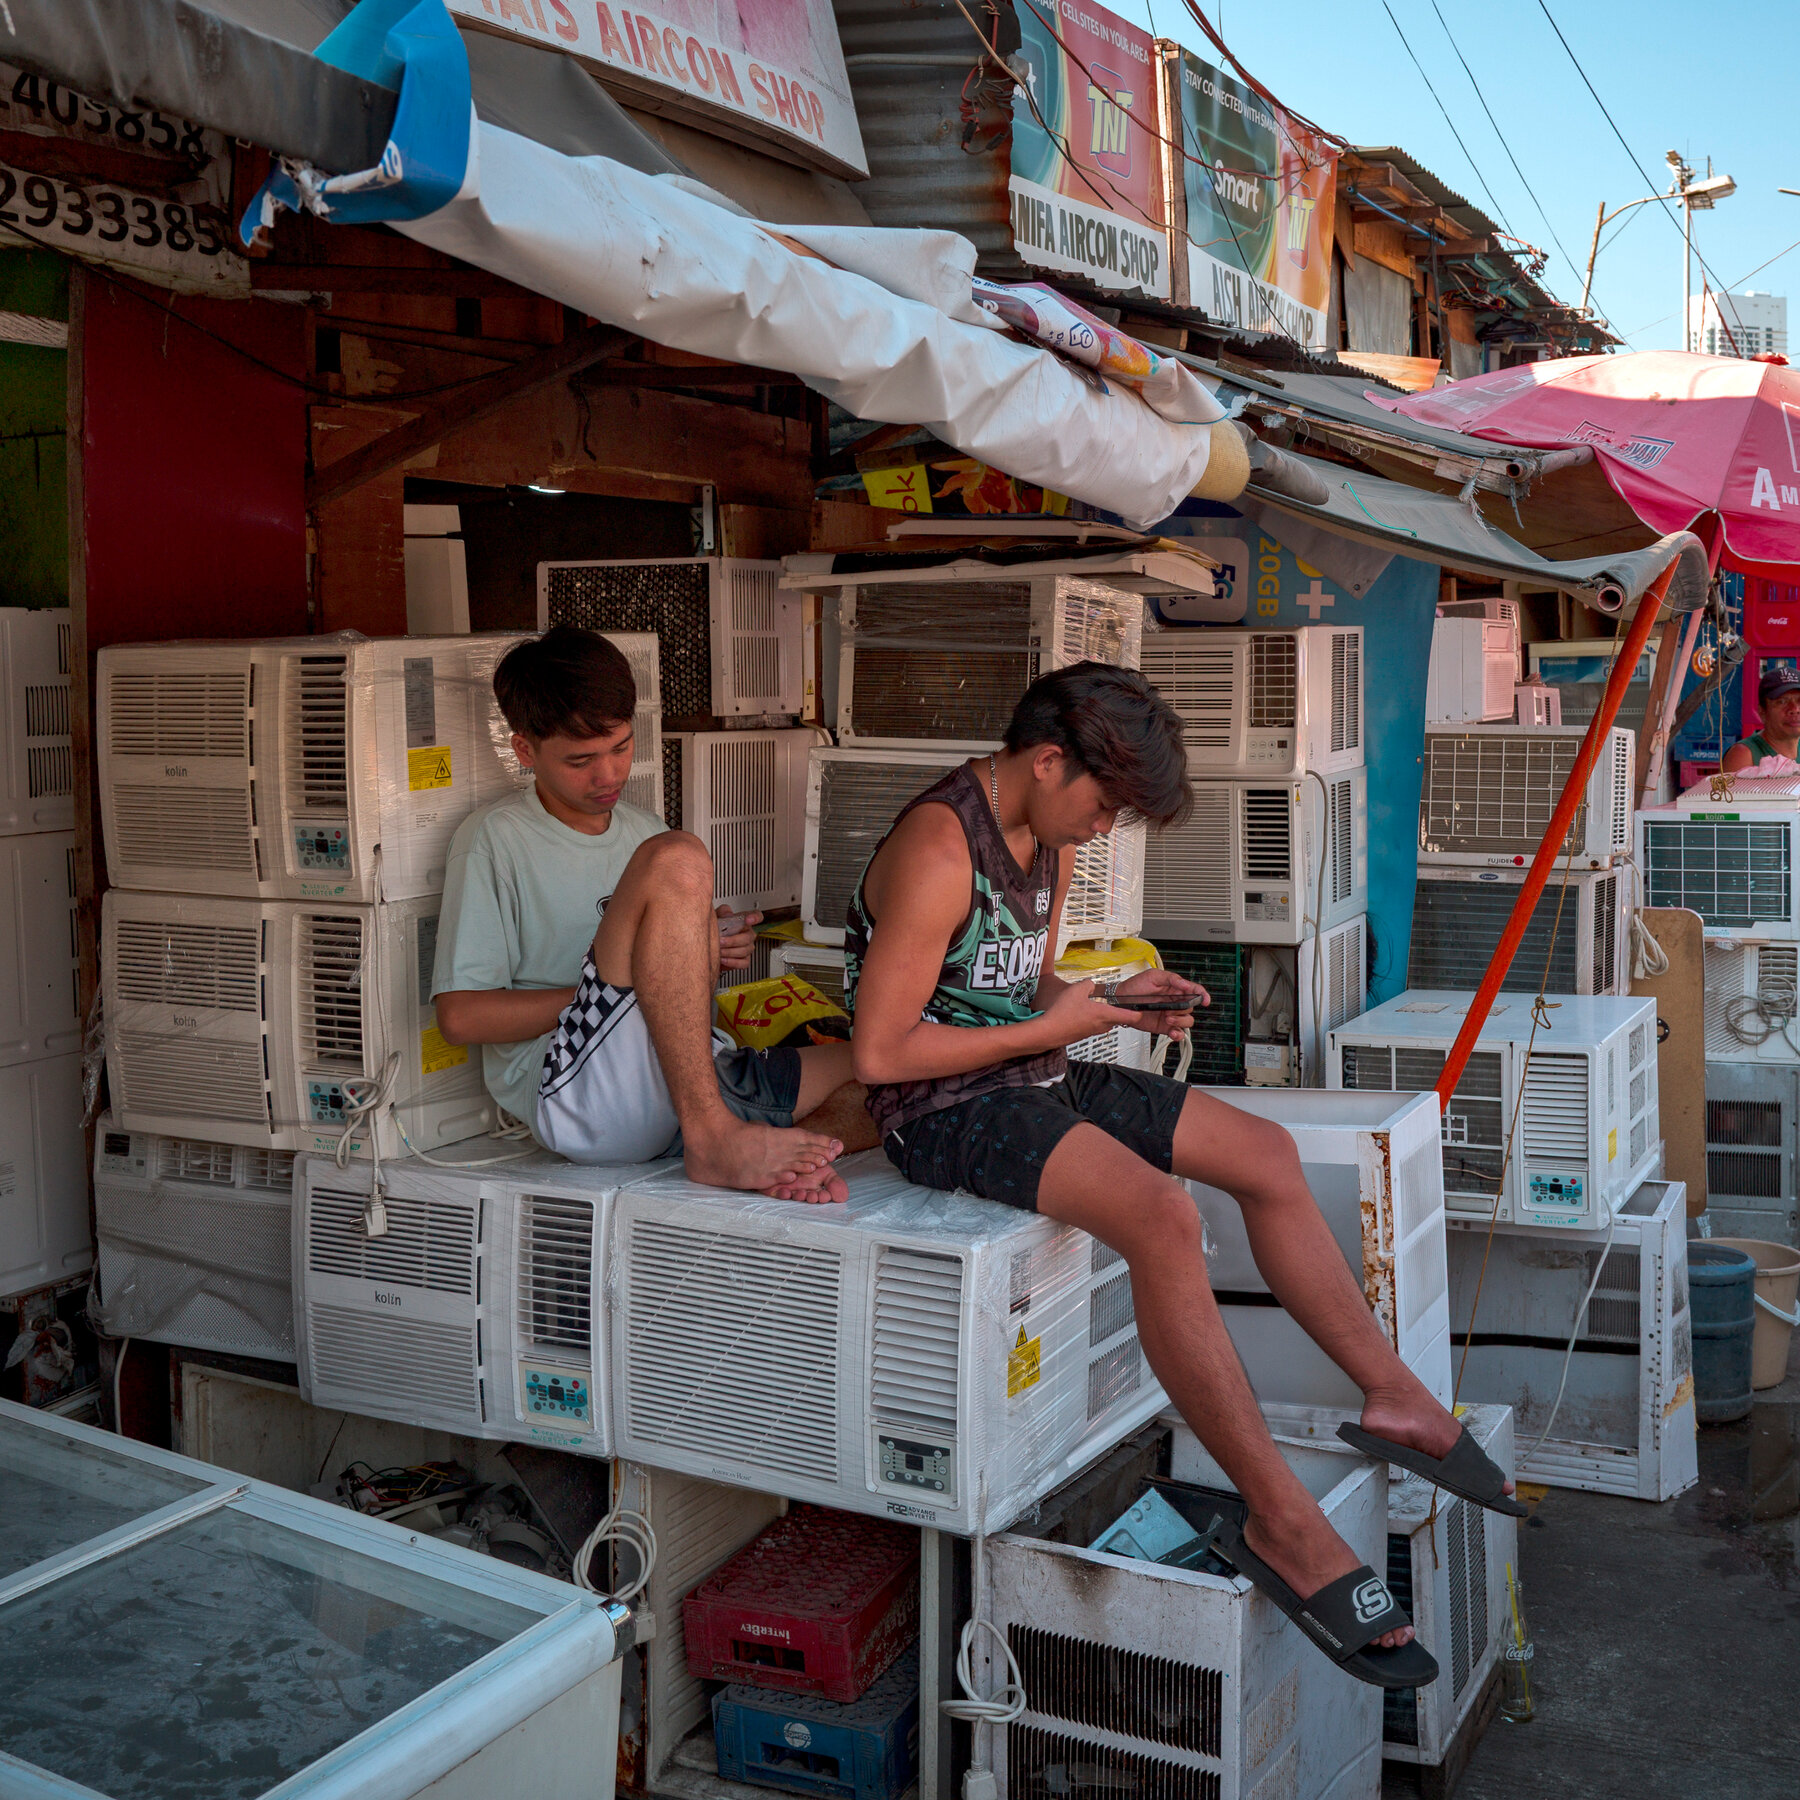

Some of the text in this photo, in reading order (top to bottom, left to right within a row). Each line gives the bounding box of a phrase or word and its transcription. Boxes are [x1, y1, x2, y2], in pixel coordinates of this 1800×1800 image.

[1062, 2, 1080, 25] CELL
[1080, 12, 1099, 36] SITES
[1100, 23, 1109, 43] IN
[1109, 28, 1130, 55] YOUR
[1130, 41, 1150, 65] AREA
[596, 2, 745, 107] AIRCON
[748, 63, 825, 142] SHOP
[1184, 68, 1201, 91] STAY
[1202, 79, 1243, 115] CONNECTED
[1243, 102, 1261, 125] WITH
[1087, 82, 1134, 157] TNT
[1059, 208, 1118, 273] AIRCON
[1120, 228, 1159, 287] SHOP
[1212, 262, 1242, 329] AISH
[1256, 536, 1282, 617] 20GB
[165, 765, 188, 777] kolin
[1704, 812, 1726, 821] kolin
[173, 1013, 197, 1028] kolin
[374, 1290, 402, 1306] kolin
[908, 1506, 937, 1516] ADVANCE
[908, 1511, 937, 1522] INVERTER
